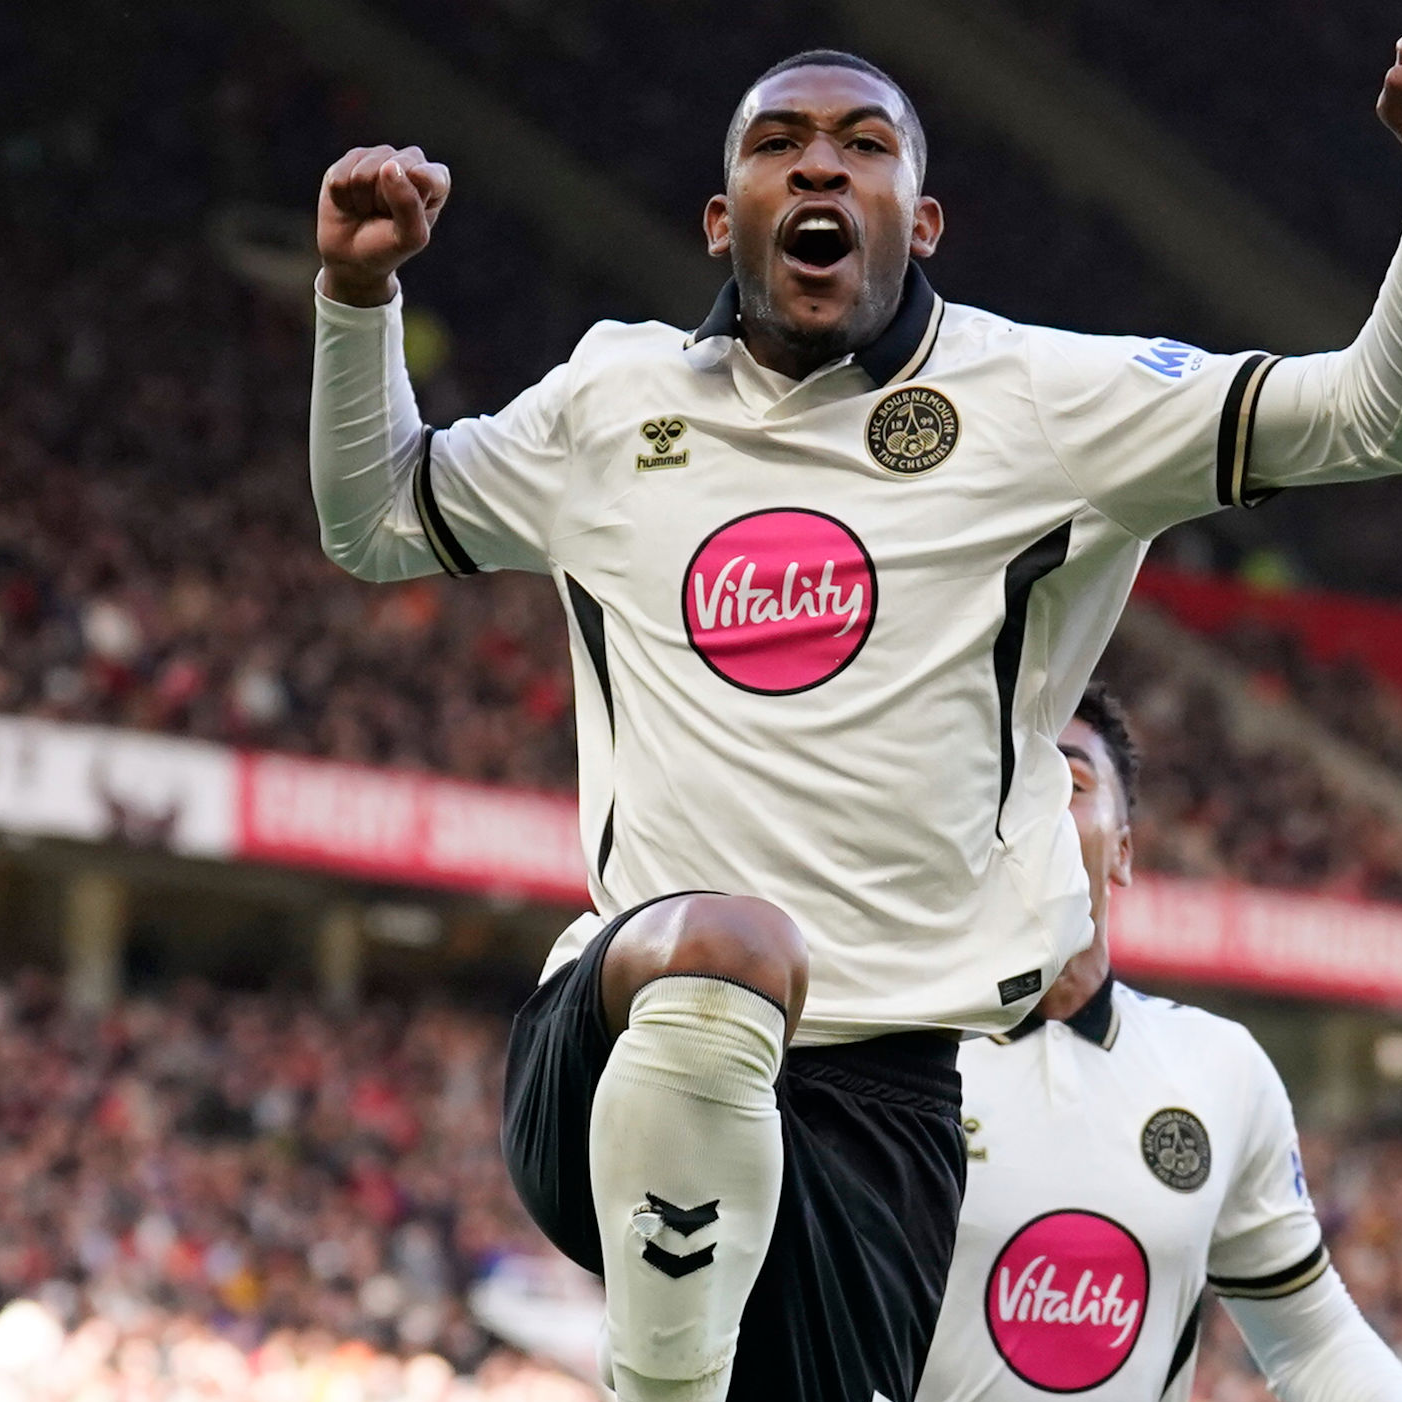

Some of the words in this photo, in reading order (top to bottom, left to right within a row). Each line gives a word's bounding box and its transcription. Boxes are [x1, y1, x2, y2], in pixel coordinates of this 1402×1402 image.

[871, 418, 884, 441] AFC
[879, 391, 955, 433] BOURNEMOUTH
[891, 420, 903, 430] 18
[637, 452, 687, 469] hummel
[878, 449, 898, 467] THE
[898, 443, 950, 469] CHERRIES
[695, 555, 863, 638] Vitality
[999, 1255, 1139, 1348] Vitality
